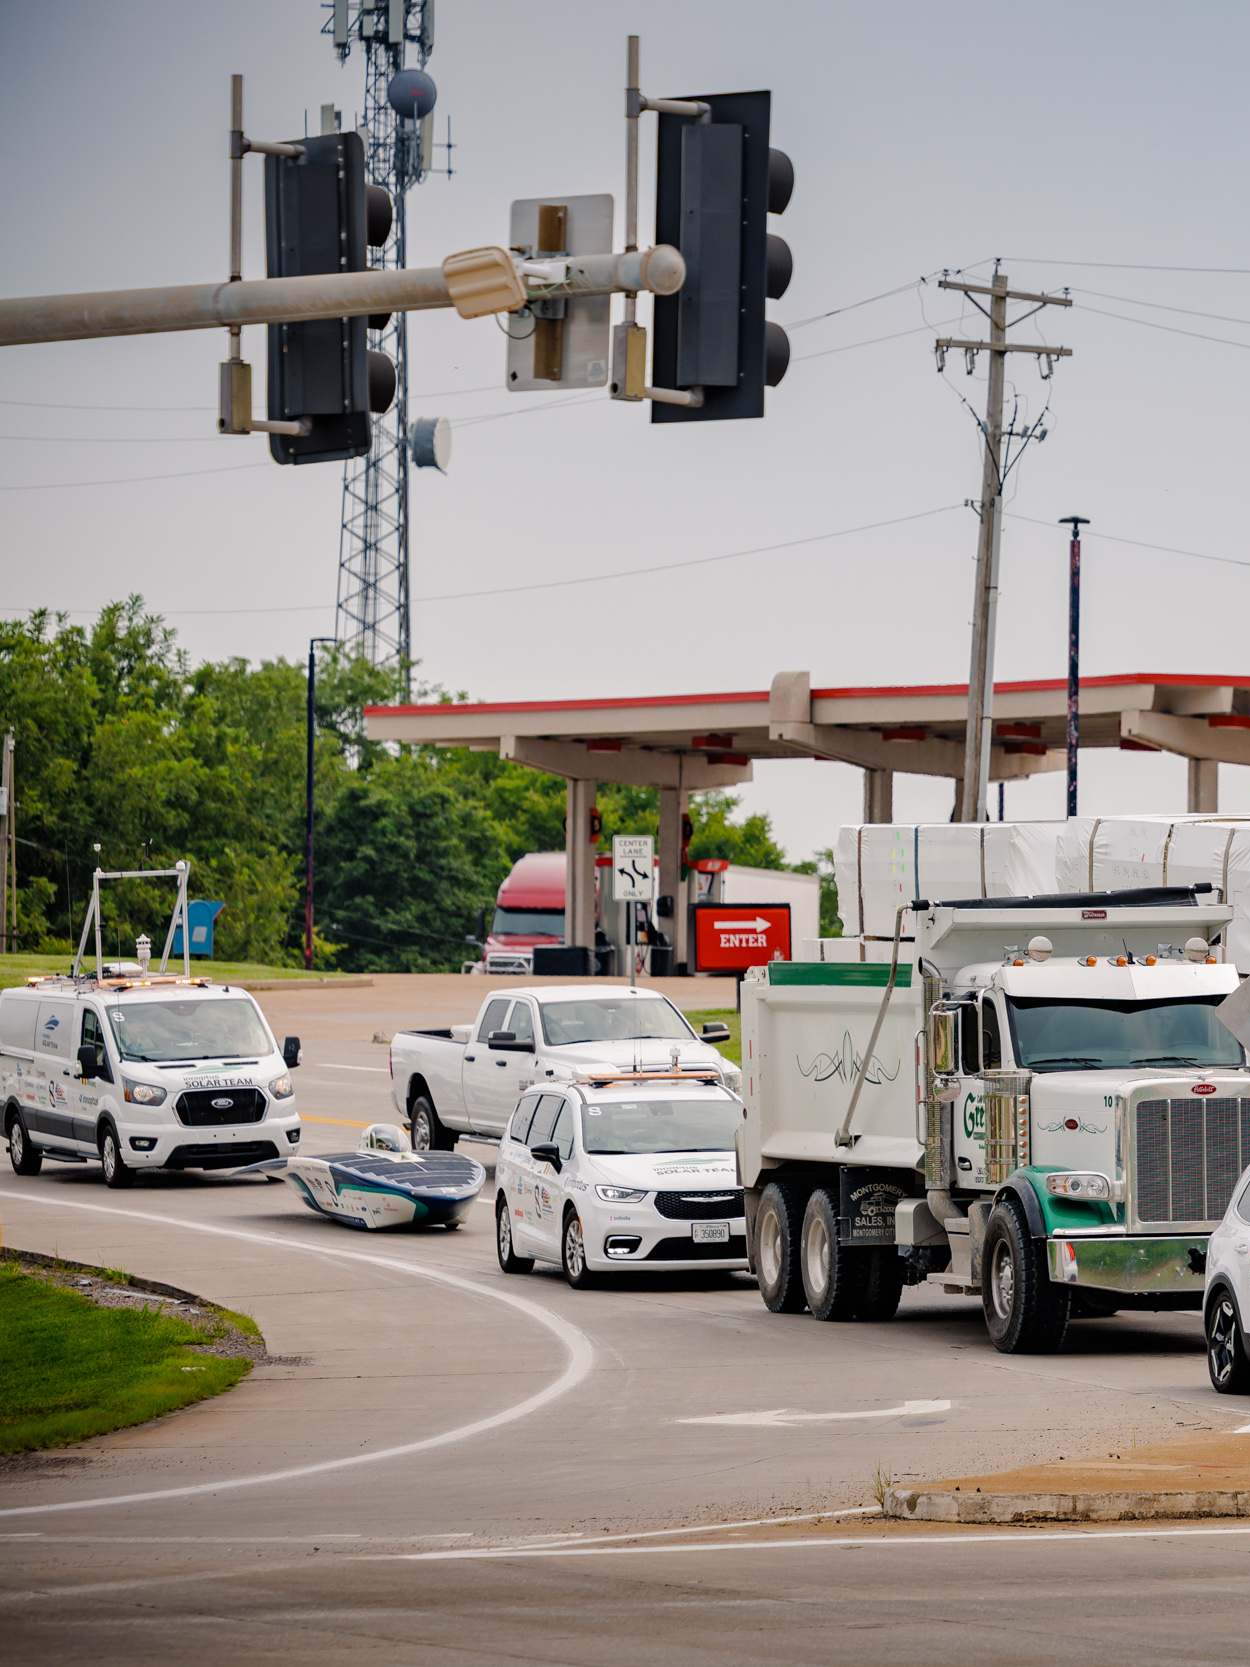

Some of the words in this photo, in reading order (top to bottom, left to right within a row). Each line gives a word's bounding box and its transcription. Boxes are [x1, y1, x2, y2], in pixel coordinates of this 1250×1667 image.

[622, 890, 644, 898] ONLY
[719, 933, 768, 948] ENTER
[185, 1079, 221, 1088] SOLAR
[222, 1078, 253, 1086] TEAM
[1104, 1095, 1113, 1108] 10
[656, 1168, 701, 1176] SOLAR
[850, 1183, 908, 1201] MONTGOMERY
[855, 1216, 885, 1227] SALES,
[886, 1216, 895, 1225] IN
[852, 1229, 884, 1237] MONTGOMERY
